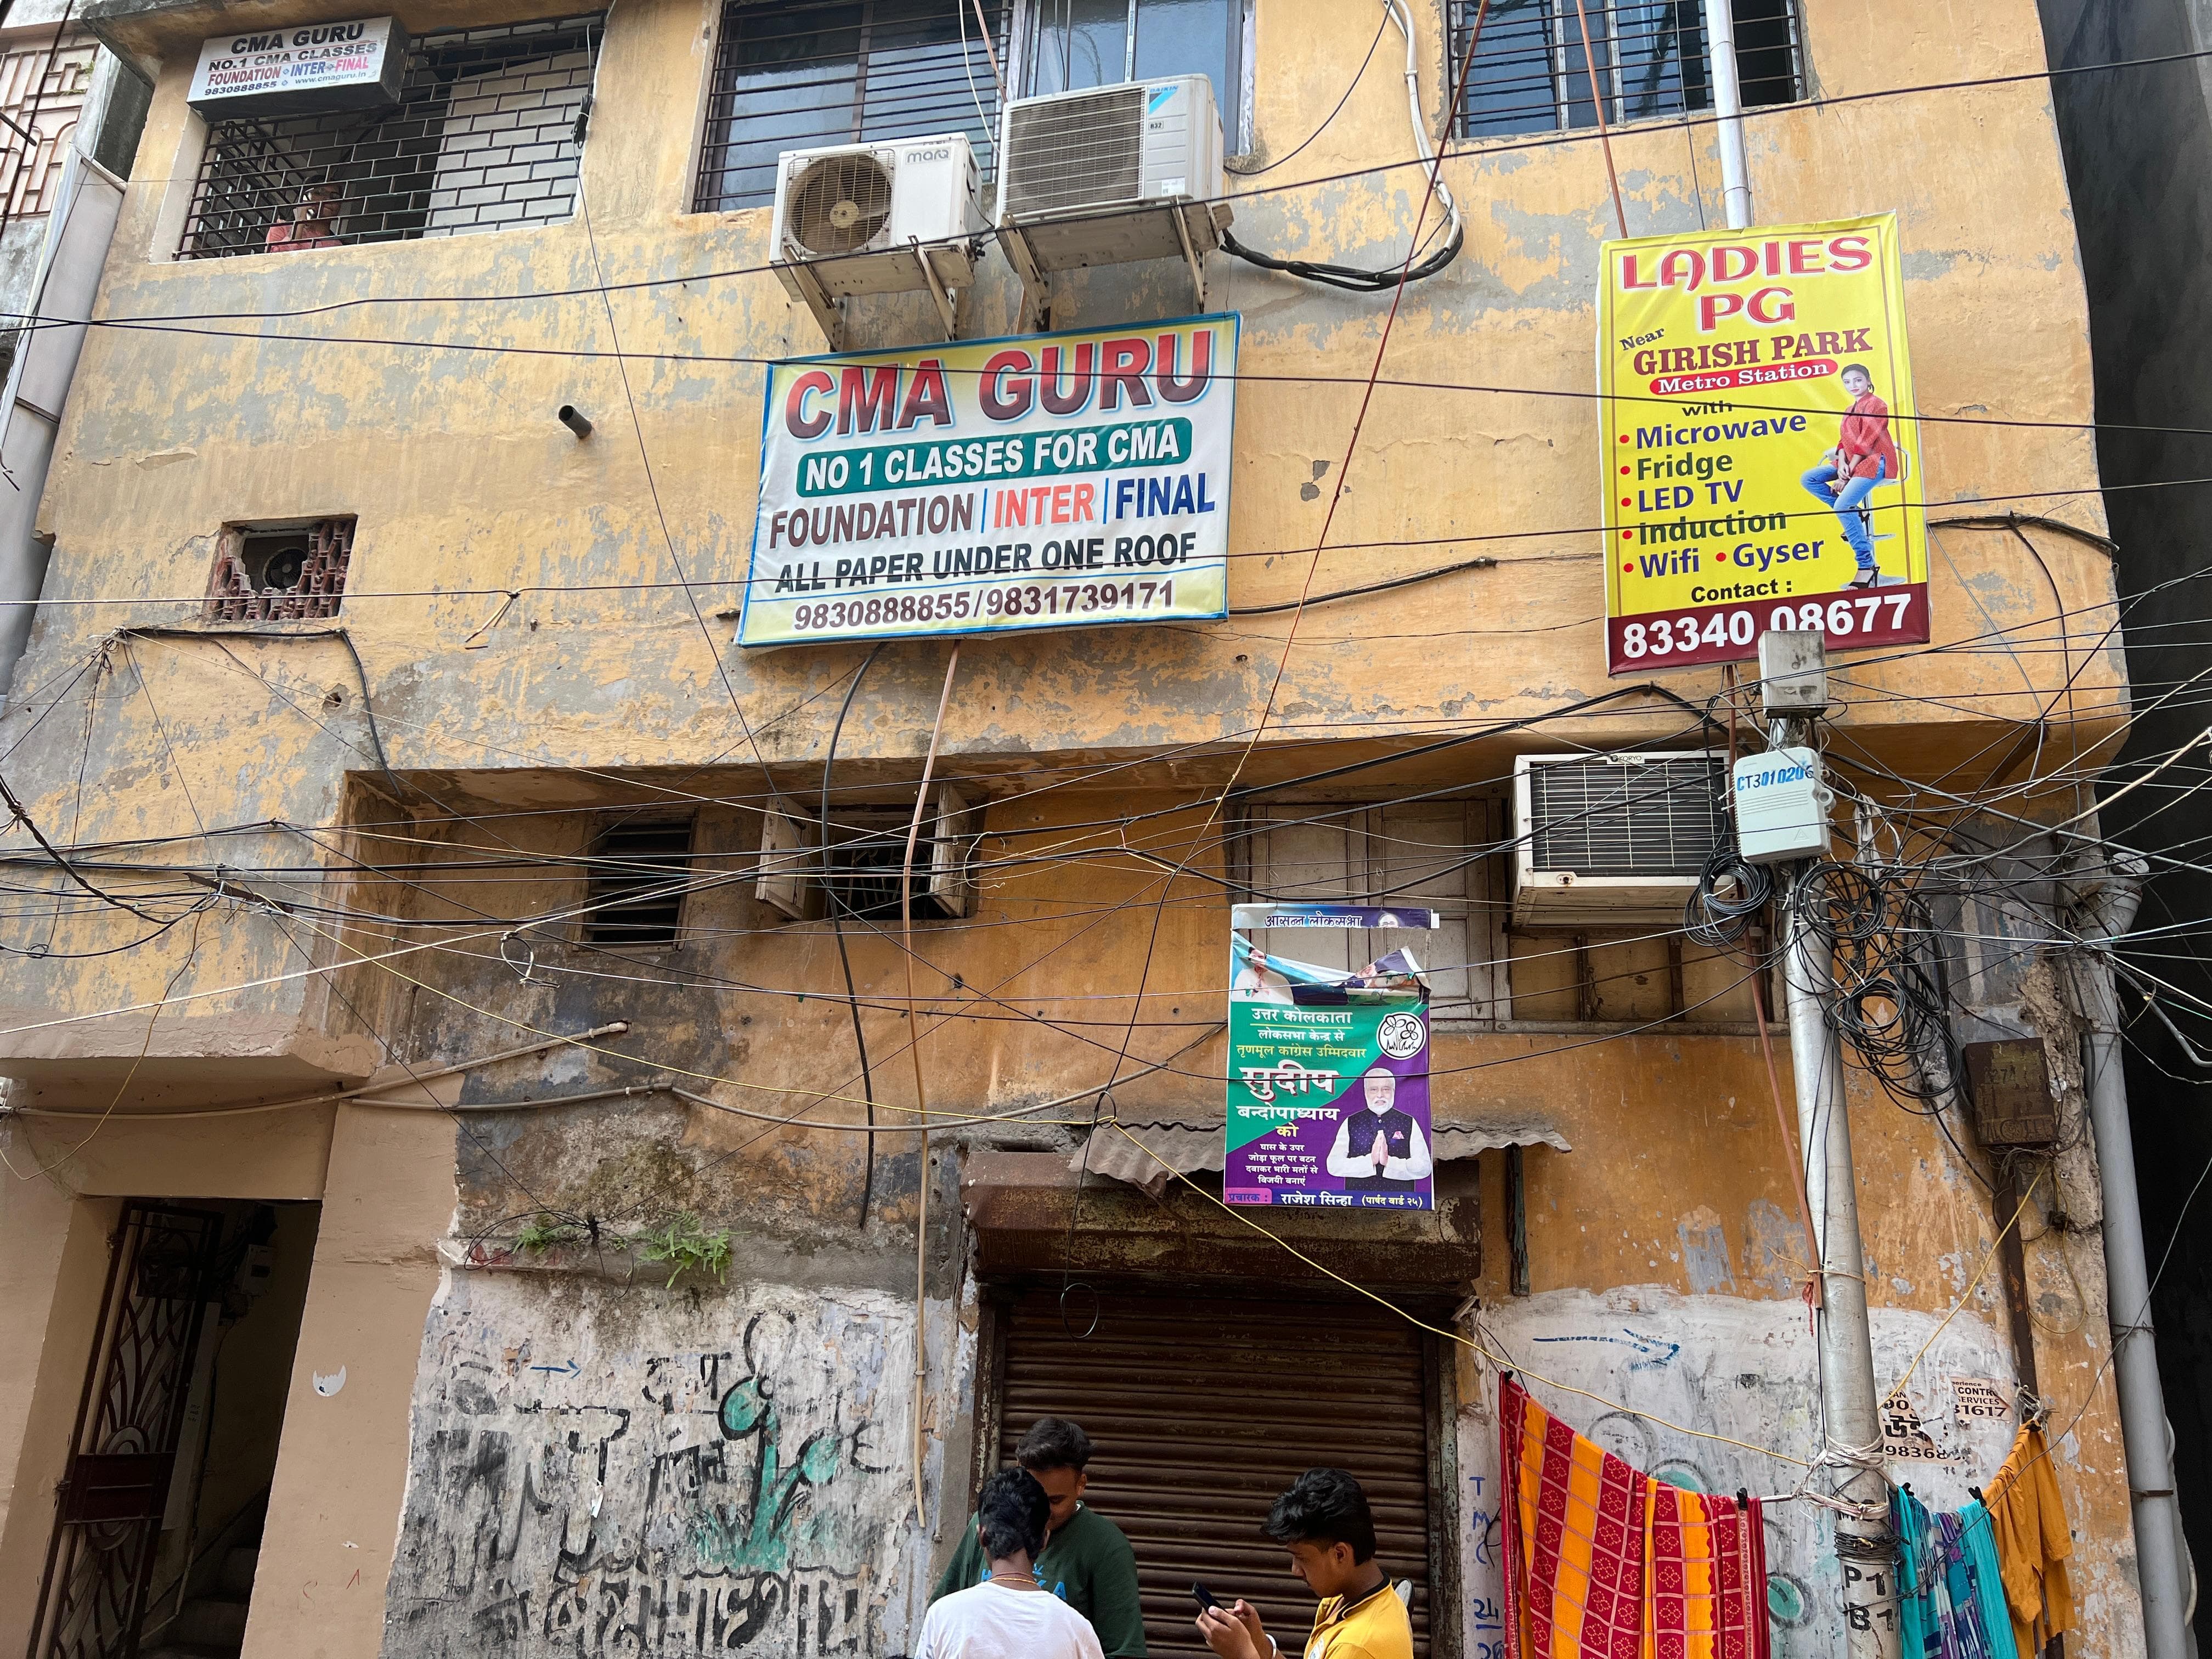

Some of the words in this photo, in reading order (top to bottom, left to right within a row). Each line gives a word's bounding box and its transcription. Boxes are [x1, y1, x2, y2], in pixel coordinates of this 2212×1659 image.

[231, 33, 284, 54] CMA
[292, 23, 364, 47] GURU
[207, 66, 282, 86] FOUNDATION
[290, 61, 326, 77] INTER
[335, 57, 369, 72] FINAL
[208, 58, 247, 71] NO.1
[254, 53, 291, 66] CMA
[297, 43, 377, 60] CLASSES
[204, 81, 277, 95] 9830888855
[295, 71, 366, 84] www.cmaguru.in
[1149, 85, 1179, 93] DAIKIN
[1622, 235, 1872, 292] LADIES
[1700, 286, 1796, 331] PG
[1619, 327, 1665, 351] Near
[1633, 339, 1760, 376] GIRISH
[1770, 327, 1874, 361] PARK
[785, 358, 953, 440] CMA
[979, 329, 1212, 421] GURU
[1657, 369, 1731, 394] Metro
[1737, 360, 1830, 385] Station
[1681, 400, 1734, 417] with
[1637, 414, 1807, 450] Microwave
[805, 455, 850, 491] NO
[858, 453, 873, 486] 1
[884, 438, 1025, 483] CLASSES
[1034, 437, 1097, 471] FOR
[1107, 425, 1180, 464] CMA
[1637, 452, 1734, 481] Fridge
[1638, 485, 1694, 512] LED
[1705, 479, 1744, 503] TV
[769, 492, 975, 549] FOUNDATION
[992, 483, 1095, 528] INTER
[1115, 473, 1216, 521] FINAL
[1639, 509, 1787, 545] Induction
[774, 561, 832, 594] ALL
[835, 554, 923, 589] PAPER
[933, 543, 1032, 580] UNDER
[1041, 538, 1104, 571] ONE
[1113, 532, 1197, 568] ROOF
[1640, 548, 1701, 579] Wifi
[1733, 540, 1825, 572] Gyser
[1691, 578, 1779, 603] Contact
[1623, 611, 1755, 659] 83340
[1770, 593, 1912, 636] 08677
[1251, 1008, 1280, 1022] उत्तर
[1282, 1007, 1353, 1024] कोलकाता
[1257, 1026, 1307, 1041] लोकसभा
[1308, 1029, 1331, 1042] केन्द्र
[1333, 1029, 1346, 1042] से
[1236, 1045, 1275, 1059] तृणमूल
[1277, 1042, 1313, 1057] कांग्रेस
[1238, 1059, 1342, 1103] सुदीप
[1275, 1122, 1300, 1137] को
[1269, 1155, 1285, 1164] फूल
[1278, 1141, 1288, 1151] के
[1257, 1174, 1284, 1184] विजयी
[1273, 1164, 1291, 1173] भारी
[1310, 1165, 1319, 1174] से
[1228, 1193, 1261, 1203] प्रचारक
[1280, 1190, 1317, 1205] राजेश
[1318, 1190, 1354, 1207] सिन्हा
